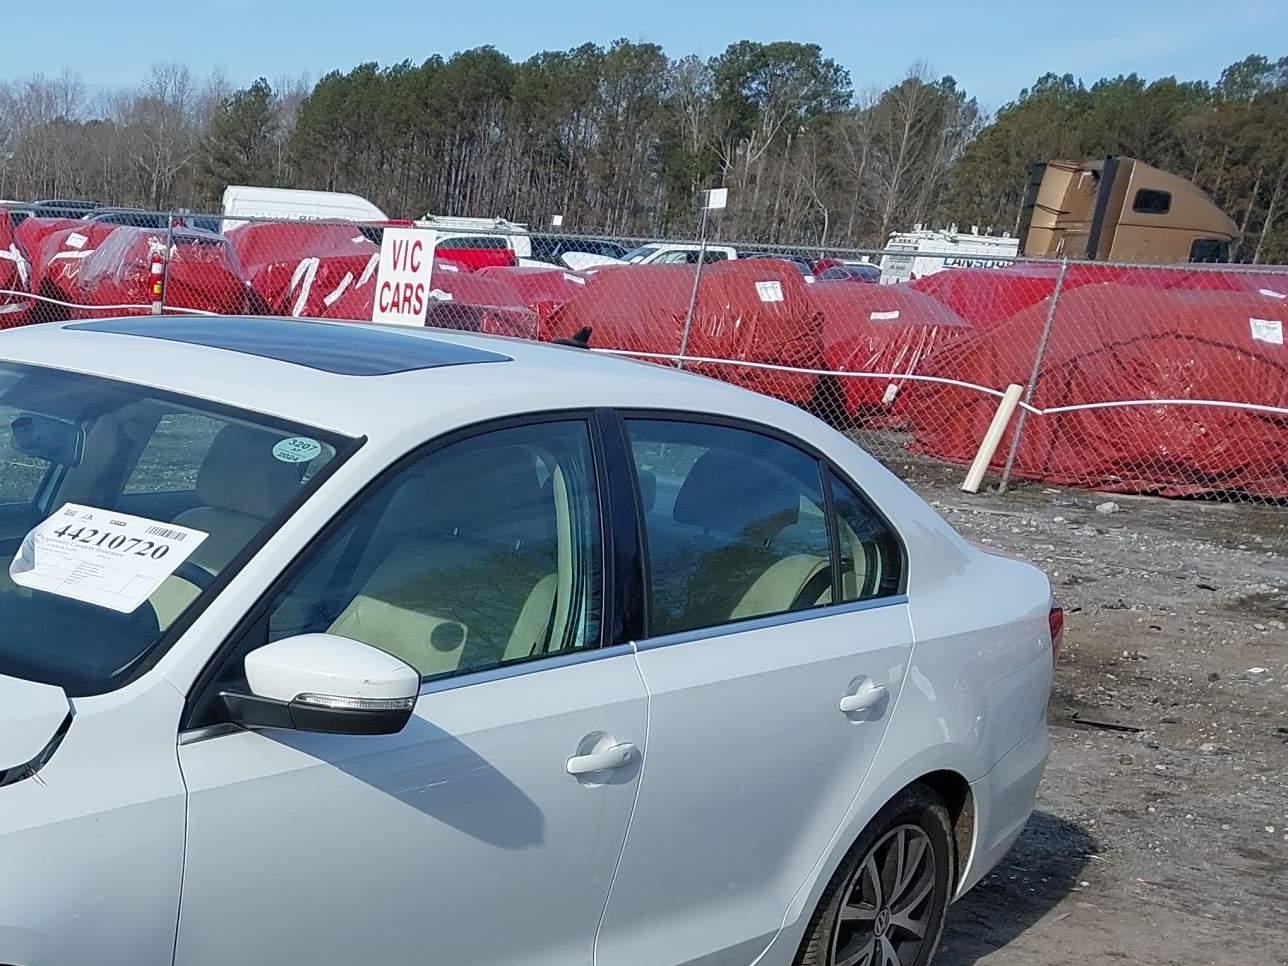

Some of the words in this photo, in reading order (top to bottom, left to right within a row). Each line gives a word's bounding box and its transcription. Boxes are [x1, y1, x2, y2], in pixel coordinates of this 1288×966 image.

[393, 239, 423, 272] VIC
[379, 280, 425, 316] CARS
[277, 451, 301, 462] 2024
[287, 439, 319, 451] 3207
[53, 523, 170, 560] 44210720
